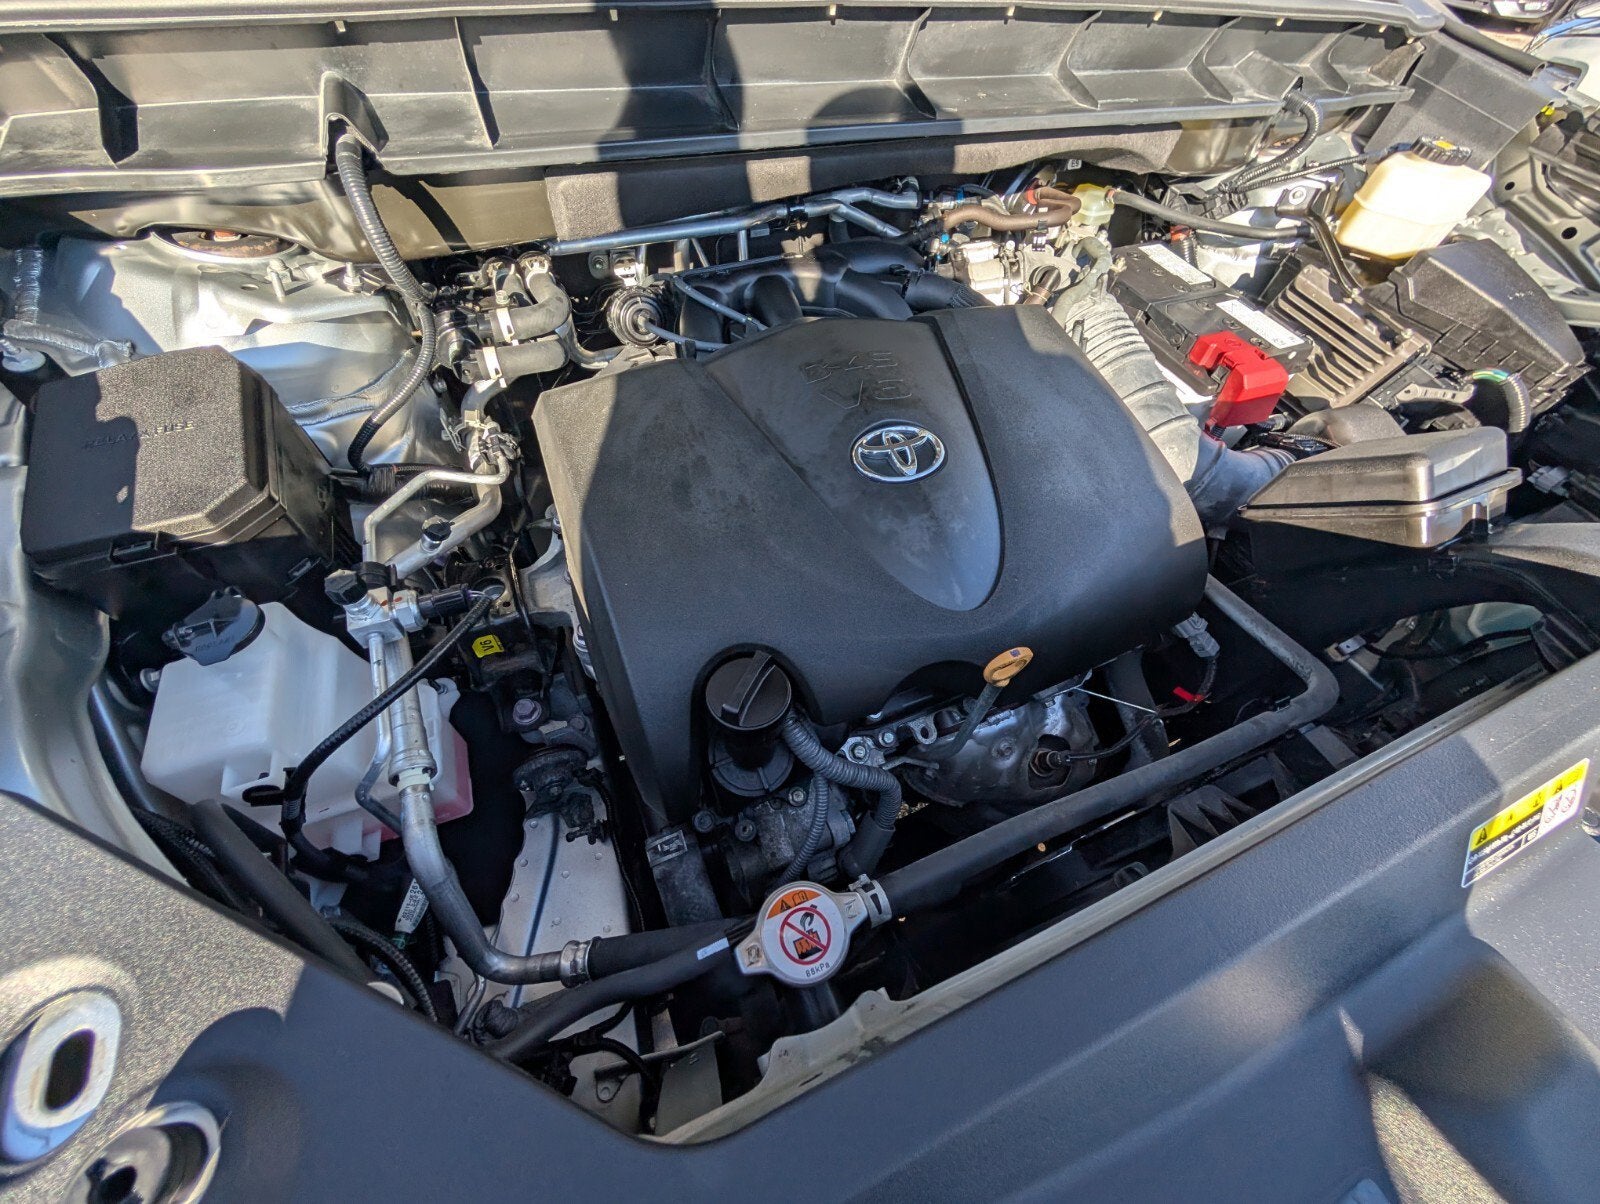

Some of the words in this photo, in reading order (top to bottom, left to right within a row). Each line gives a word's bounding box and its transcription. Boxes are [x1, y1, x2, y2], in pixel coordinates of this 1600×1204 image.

[818, 378, 913, 410] V6
[153, 420, 195, 437] FUSE
[480, 639, 495, 651] V6
